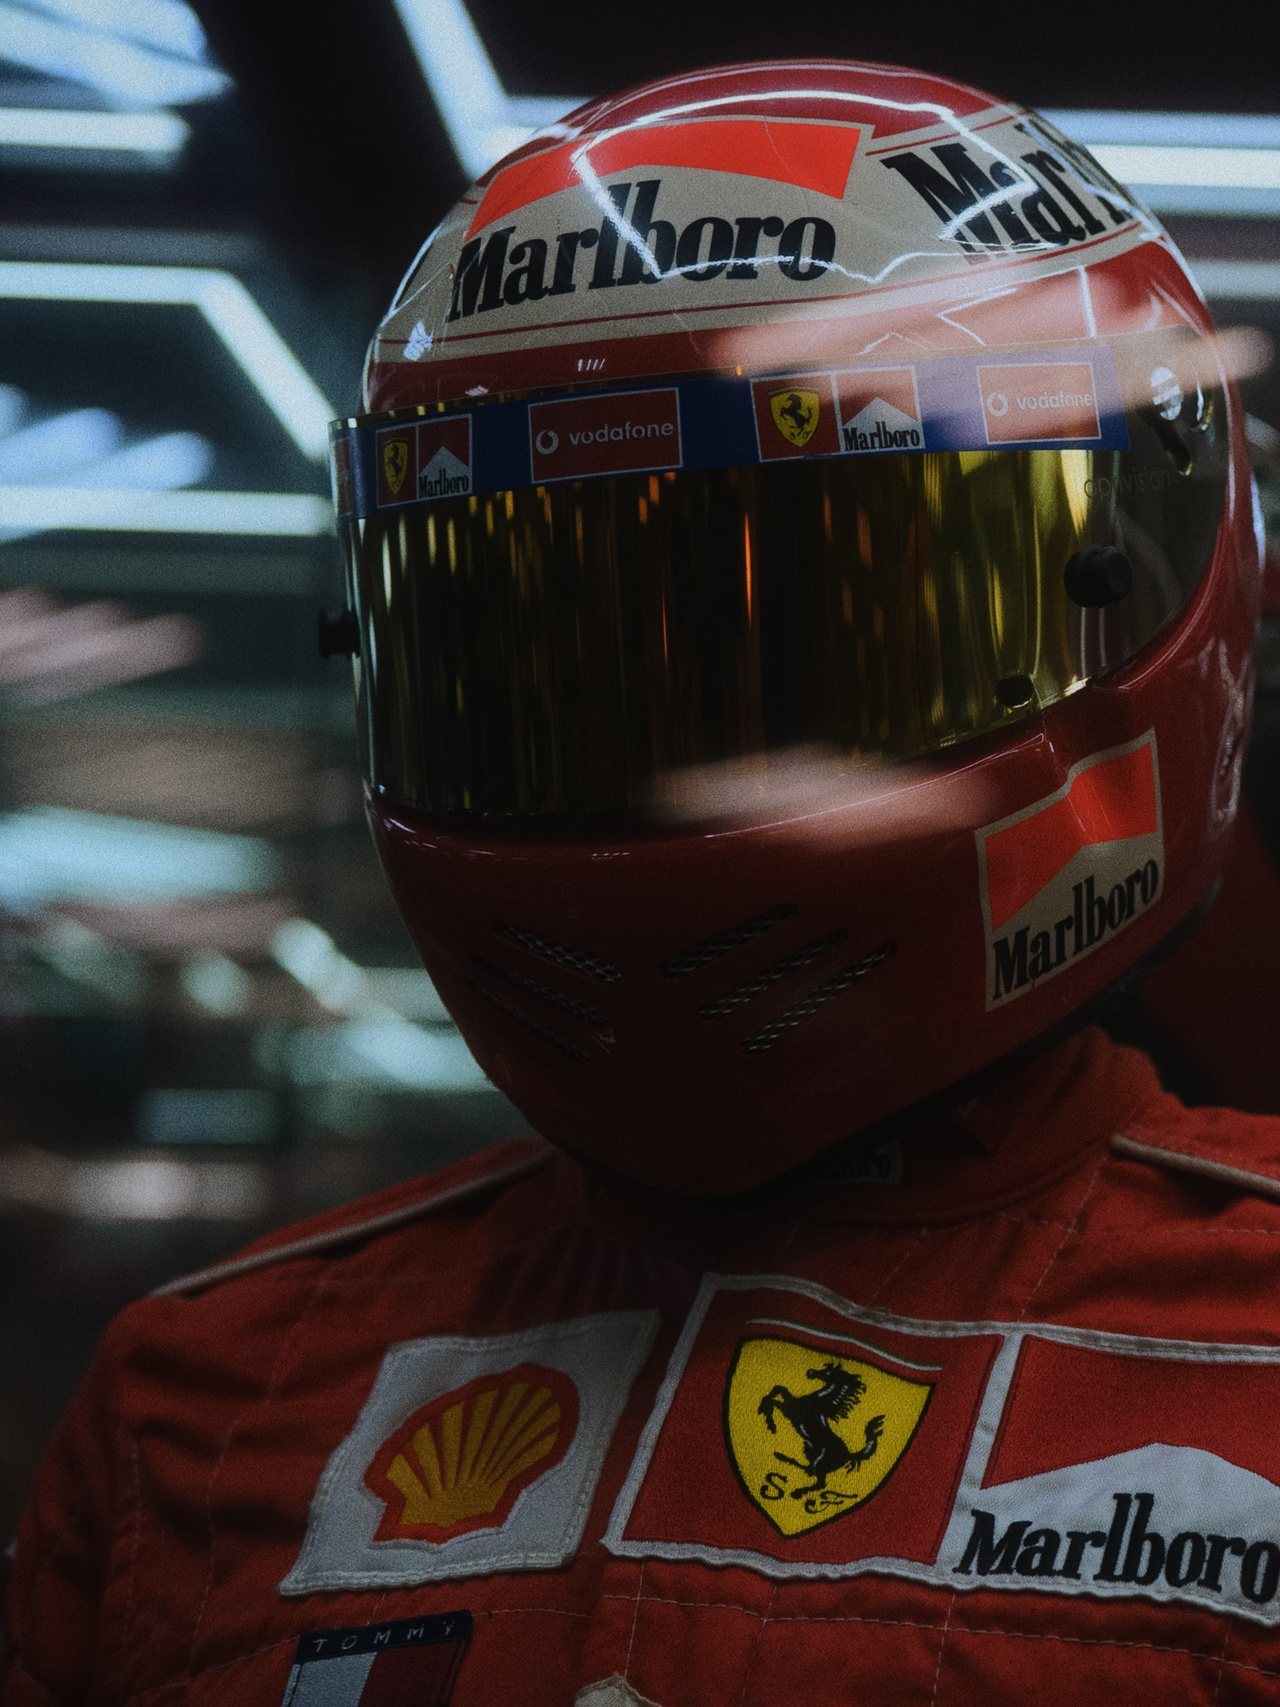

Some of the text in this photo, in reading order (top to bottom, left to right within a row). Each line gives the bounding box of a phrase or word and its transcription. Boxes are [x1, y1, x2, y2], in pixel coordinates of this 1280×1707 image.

[446, 179, 836, 323] Marlboro
[1017, 388, 1093, 411] vodafone
[568, 420, 675, 447] vodafone
[842, 421, 921, 451] Marlboro
[418, 469, 470, 499] Marlboro
[992, 859, 1160, 1001] Marlboro
[313, 1620, 457, 1654] TOMMY
